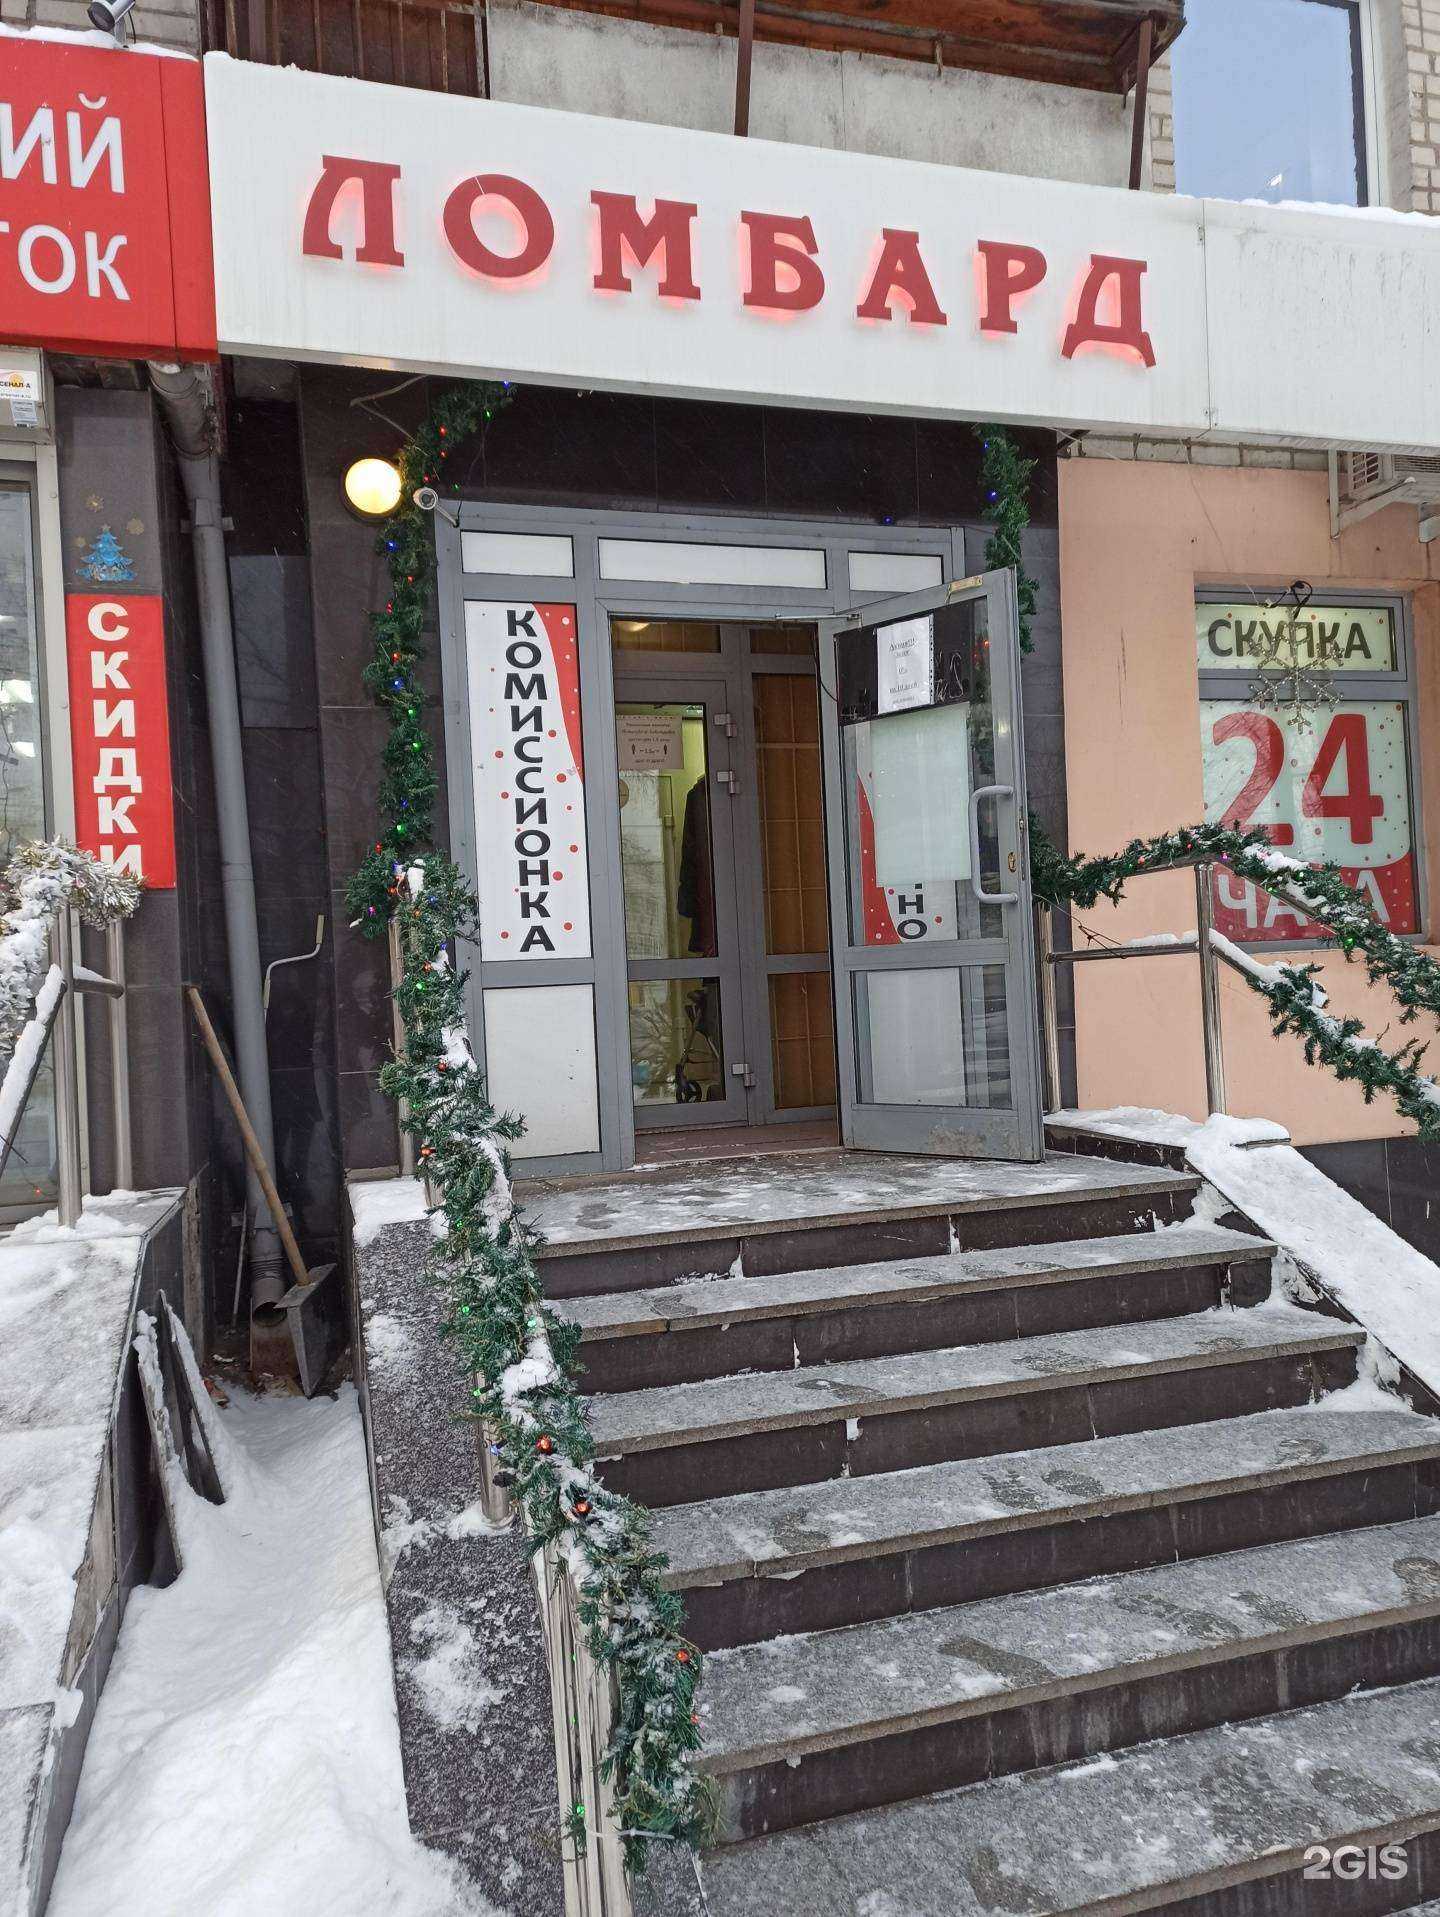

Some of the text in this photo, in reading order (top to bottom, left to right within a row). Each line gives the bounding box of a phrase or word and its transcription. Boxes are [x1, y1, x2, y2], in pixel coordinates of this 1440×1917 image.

[302, 155, 1157, 368] ЛОМБАРД
[87, 602, 145, 882] СКИДКИ
[1207, 618, 1372, 660] СКУПКА
[503, 609, 556, 953] КОМИССИОНКА
[1212, 711, 1385, 847] 24
